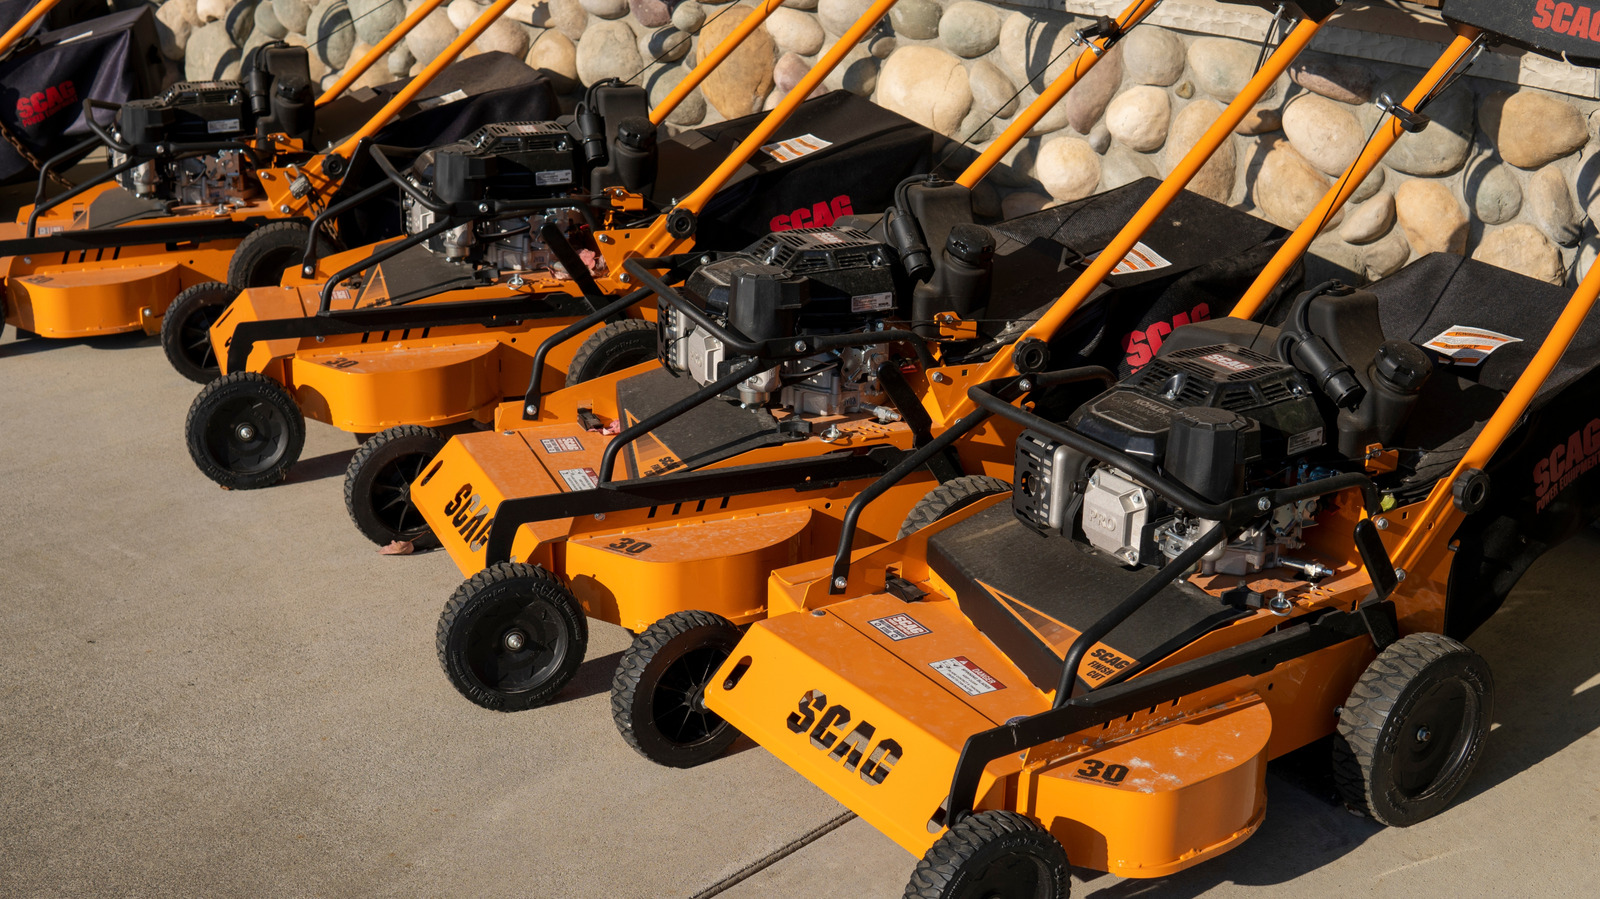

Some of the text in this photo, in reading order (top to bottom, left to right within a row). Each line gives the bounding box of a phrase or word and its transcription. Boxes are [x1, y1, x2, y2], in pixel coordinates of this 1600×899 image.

[17, 81, 77, 118] SCAG
[1533, 418, 1600, 497] SCAG
[1536, 451, 1600, 515] POWER EQUIPMEN
[444, 483, 496, 552] SCAG
[1089, 509, 1117, 532] PRO
[609, 537, 652, 553] 30
[891, 615, 925, 634] SCAG
[1087, 660, 1116, 676] FINISH
[1090, 648, 1131, 669] SCAG
[1086, 670, 1106, 681] CUT
[786, 688, 904, 786] SCAG
[1077, 759, 1130, 782] 30
